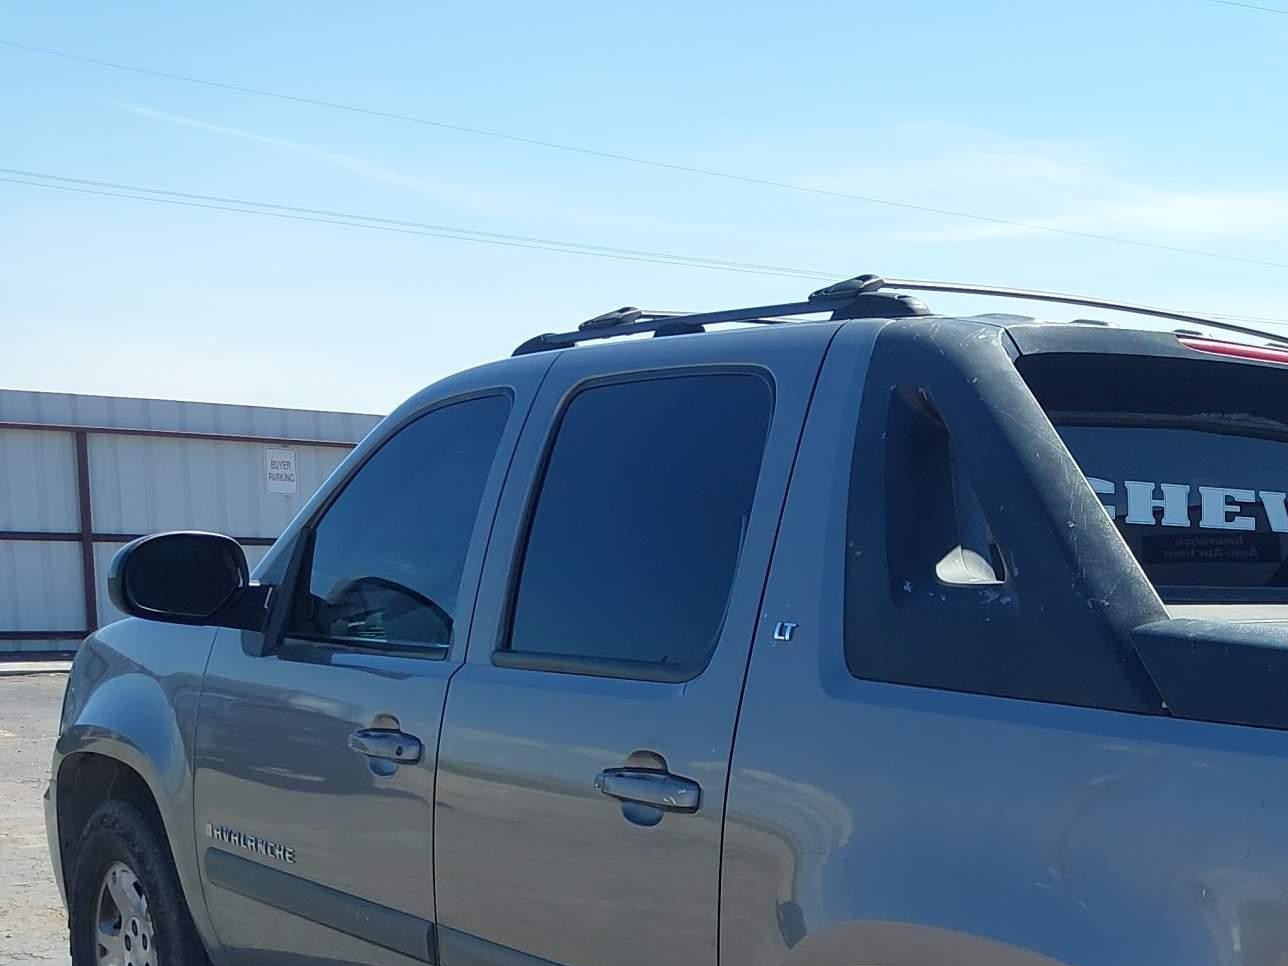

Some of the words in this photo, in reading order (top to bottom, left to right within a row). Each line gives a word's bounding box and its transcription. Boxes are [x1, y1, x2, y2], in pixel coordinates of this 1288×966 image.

[271, 460, 291, 470] BUYER
[268, 472, 295, 483] PARKING
[773, 621, 797, 641] LT
[213, 826, 295, 863] AVALANCHE
